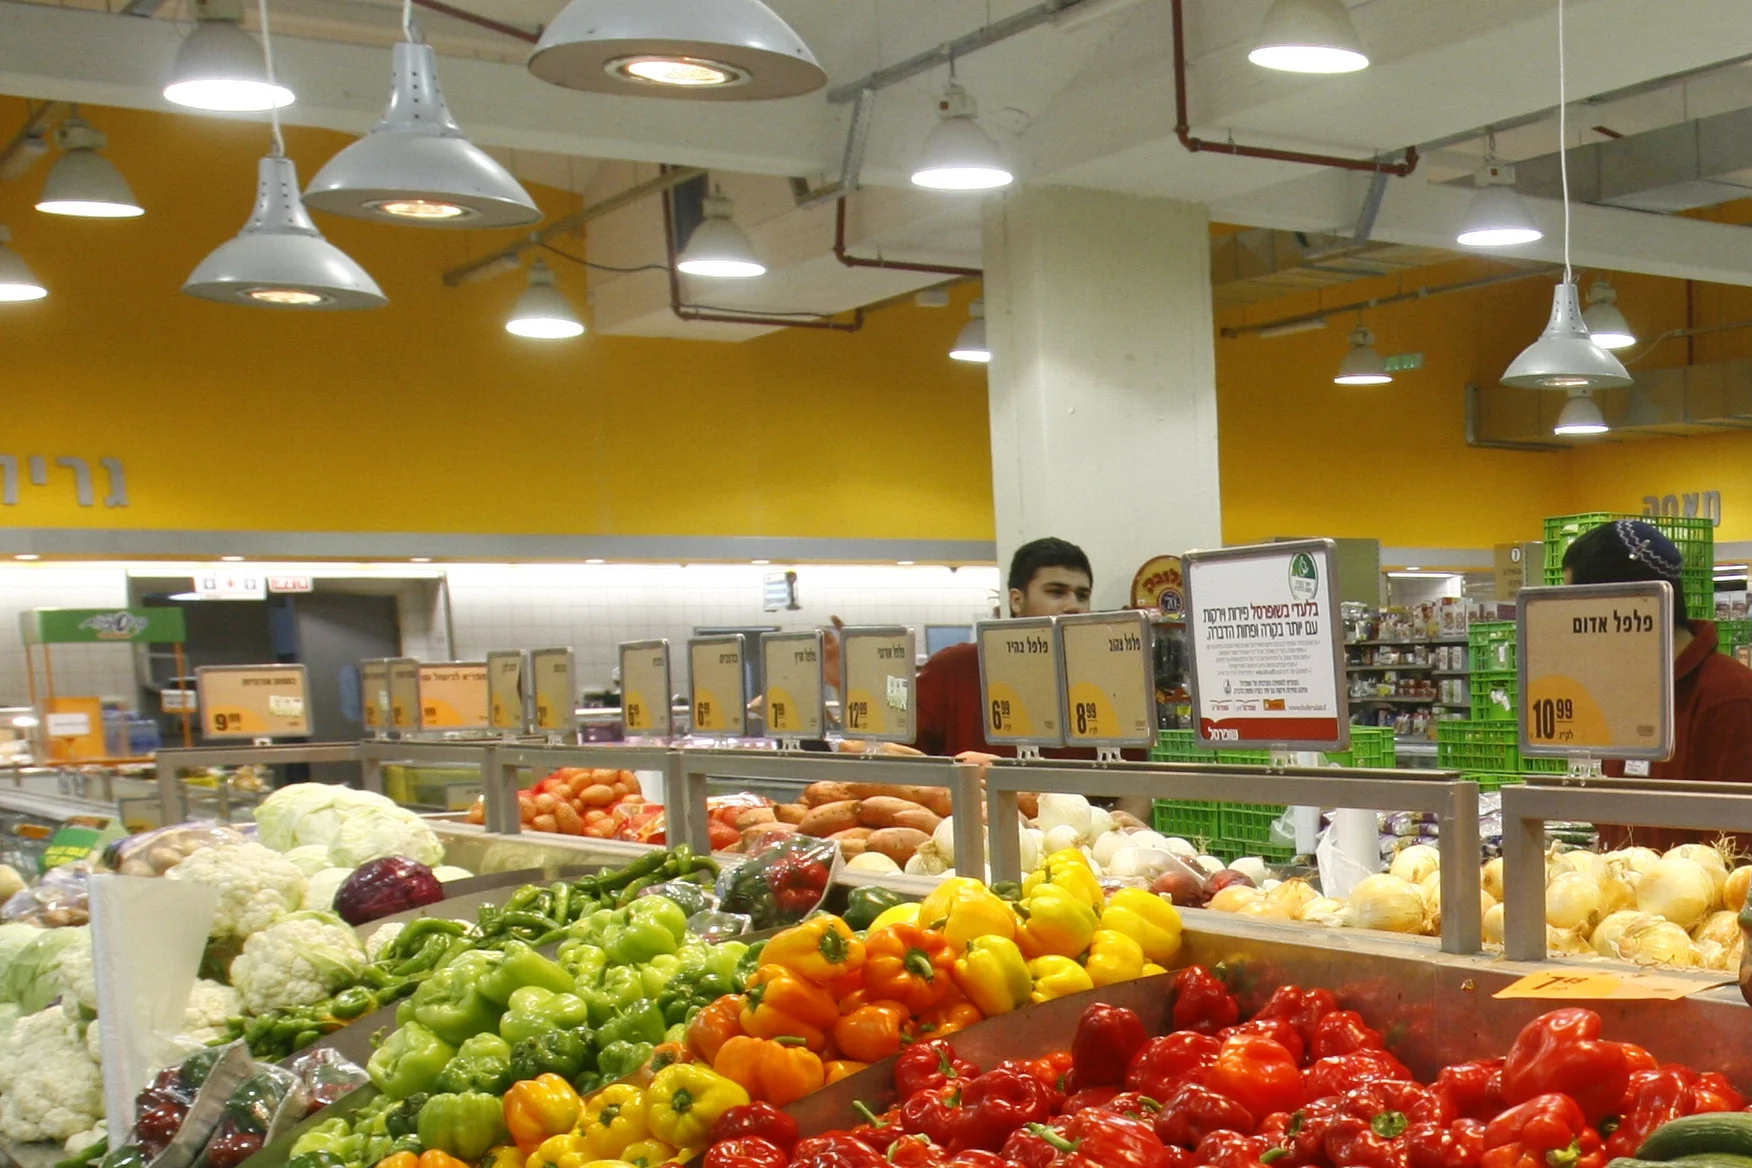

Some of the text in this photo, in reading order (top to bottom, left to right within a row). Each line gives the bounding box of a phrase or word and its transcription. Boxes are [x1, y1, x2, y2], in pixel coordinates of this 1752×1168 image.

[1203, 599, 1319, 624] בלעדי בשופרסל פירות וירקות
[1572, 609, 1653, 634] פלפל אדום
[1236, 625, 1259, 640] ופחות
[1260, 623, 1284, 640] בקרה
[1284, 621, 1303, 637] יותר
[1305, 620, 1318, 635] עם
[1026, 636, 1049, 654] פלפל
[1108, 632, 1141, 652] פלפל צהוב
[214, 713, 228, 731] 9
[848, 703, 860, 729] 12
[992, 700, 1002, 730] 6
[1076, 702, 1086, 734] 8
[1532, 698, 1573, 739] 10 99
